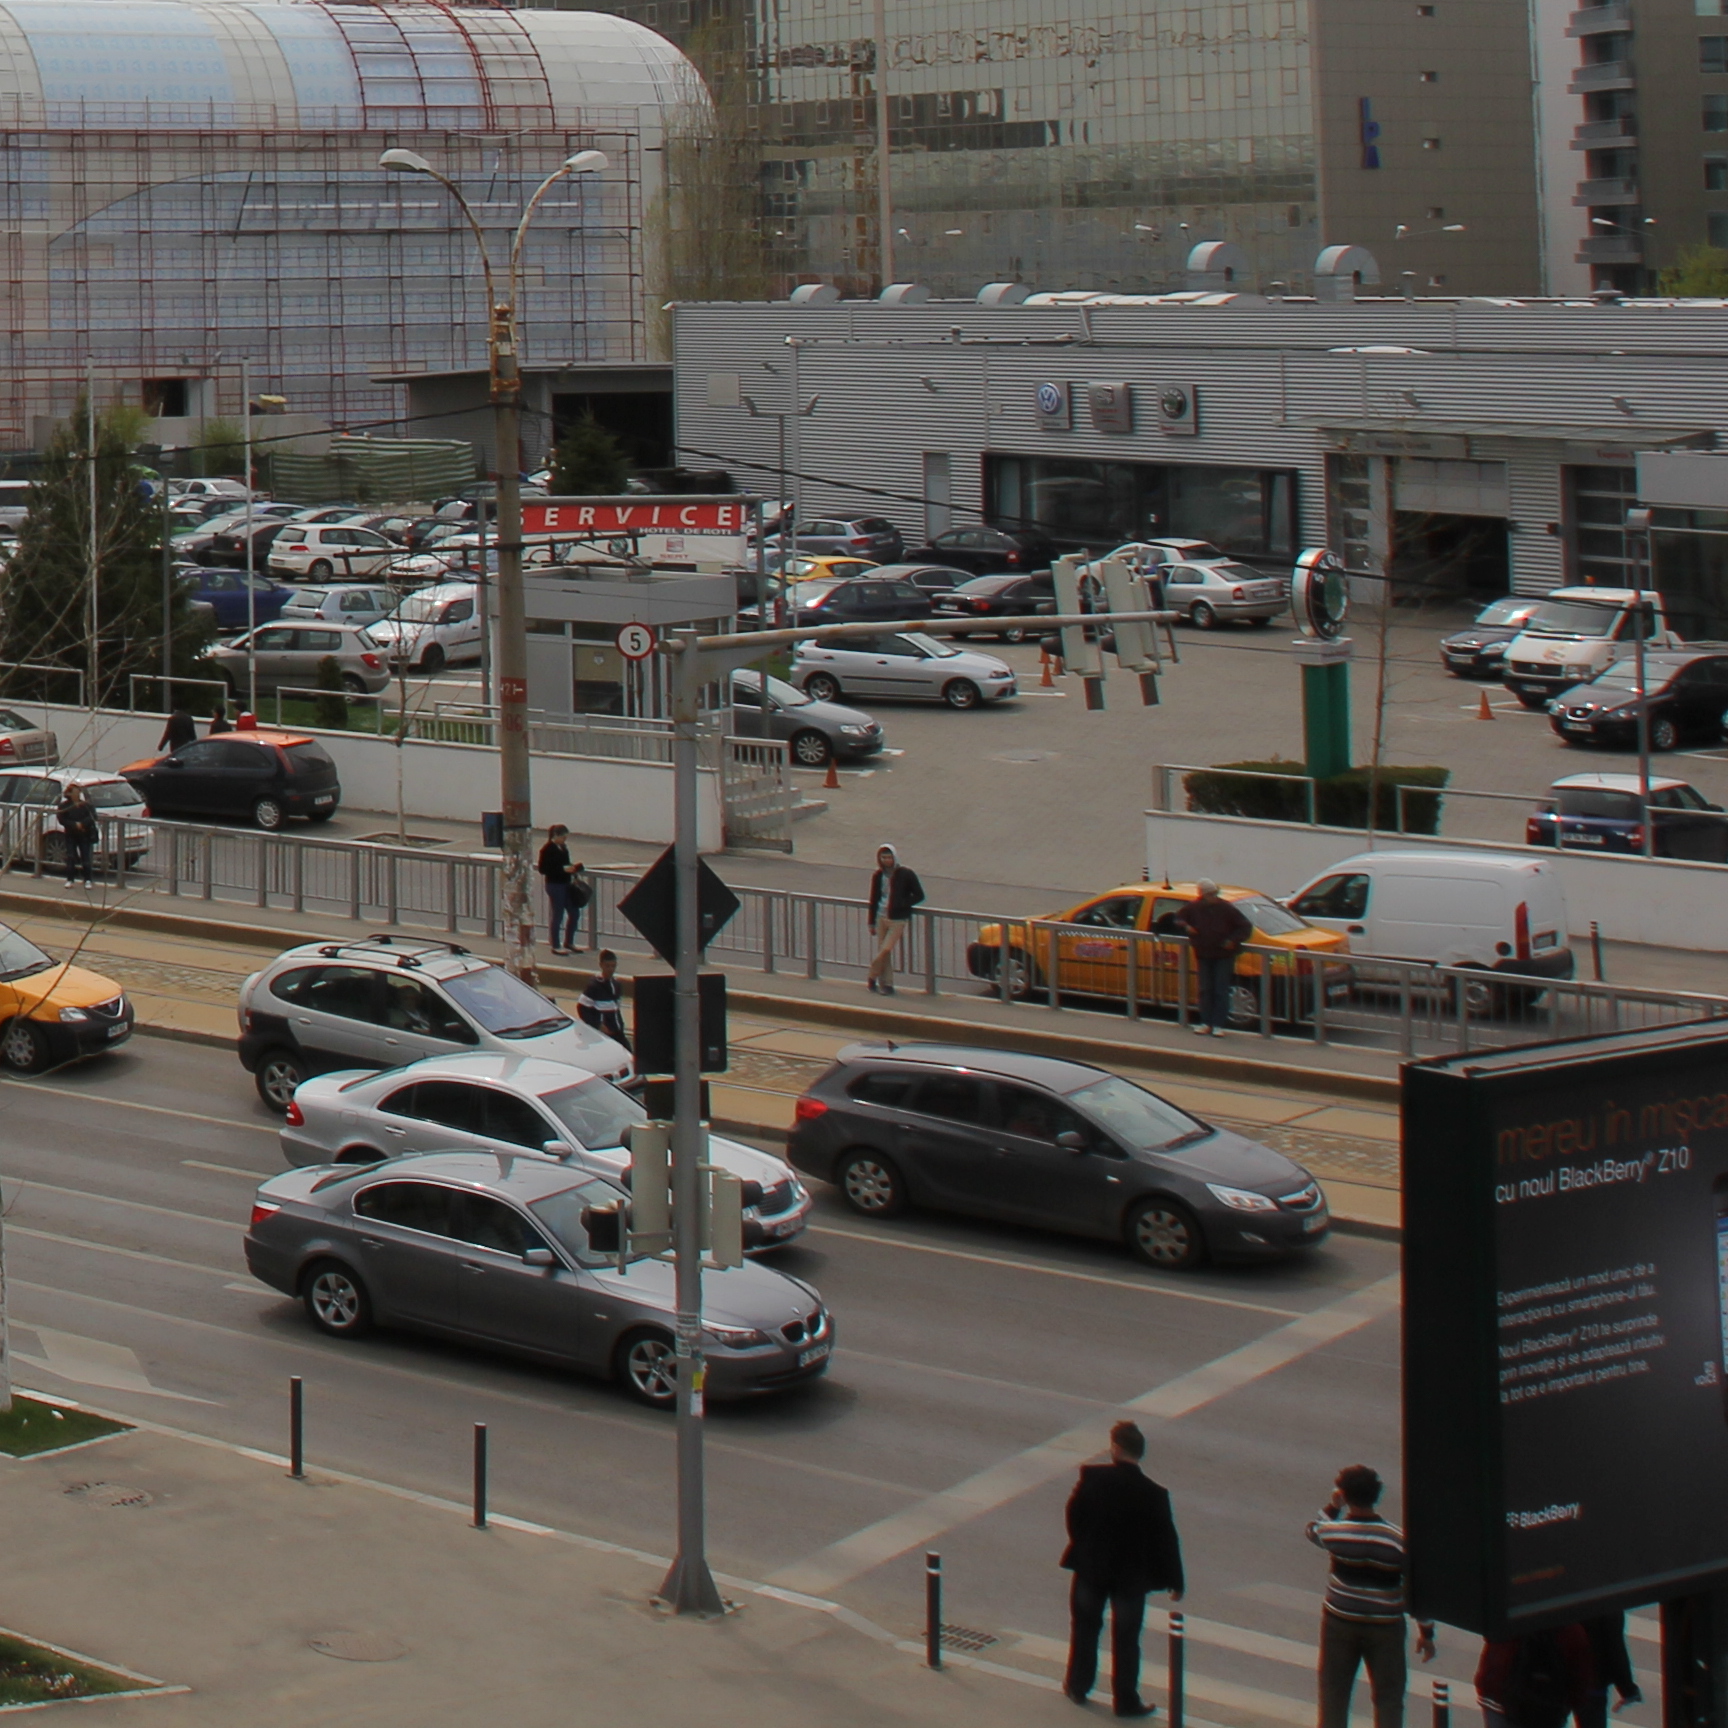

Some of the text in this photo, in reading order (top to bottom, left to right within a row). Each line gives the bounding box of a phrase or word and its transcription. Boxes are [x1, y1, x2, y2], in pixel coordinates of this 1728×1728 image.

[518, 505, 733, 527] ERVICE
[639, 527, 678, 535] HOTEL
[630, 633, 640, 652] 5
[1498, 1119, 1597, 1164] mereu
[1495, 1184, 1515, 1203] cu
[1520, 1170, 1556, 1199] noul
[1659, 1146, 1692, 1174] Z10
[1580, 1324, 1599, 1341] Z10
[1520, 1501, 1580, 1528] BlackBerry
